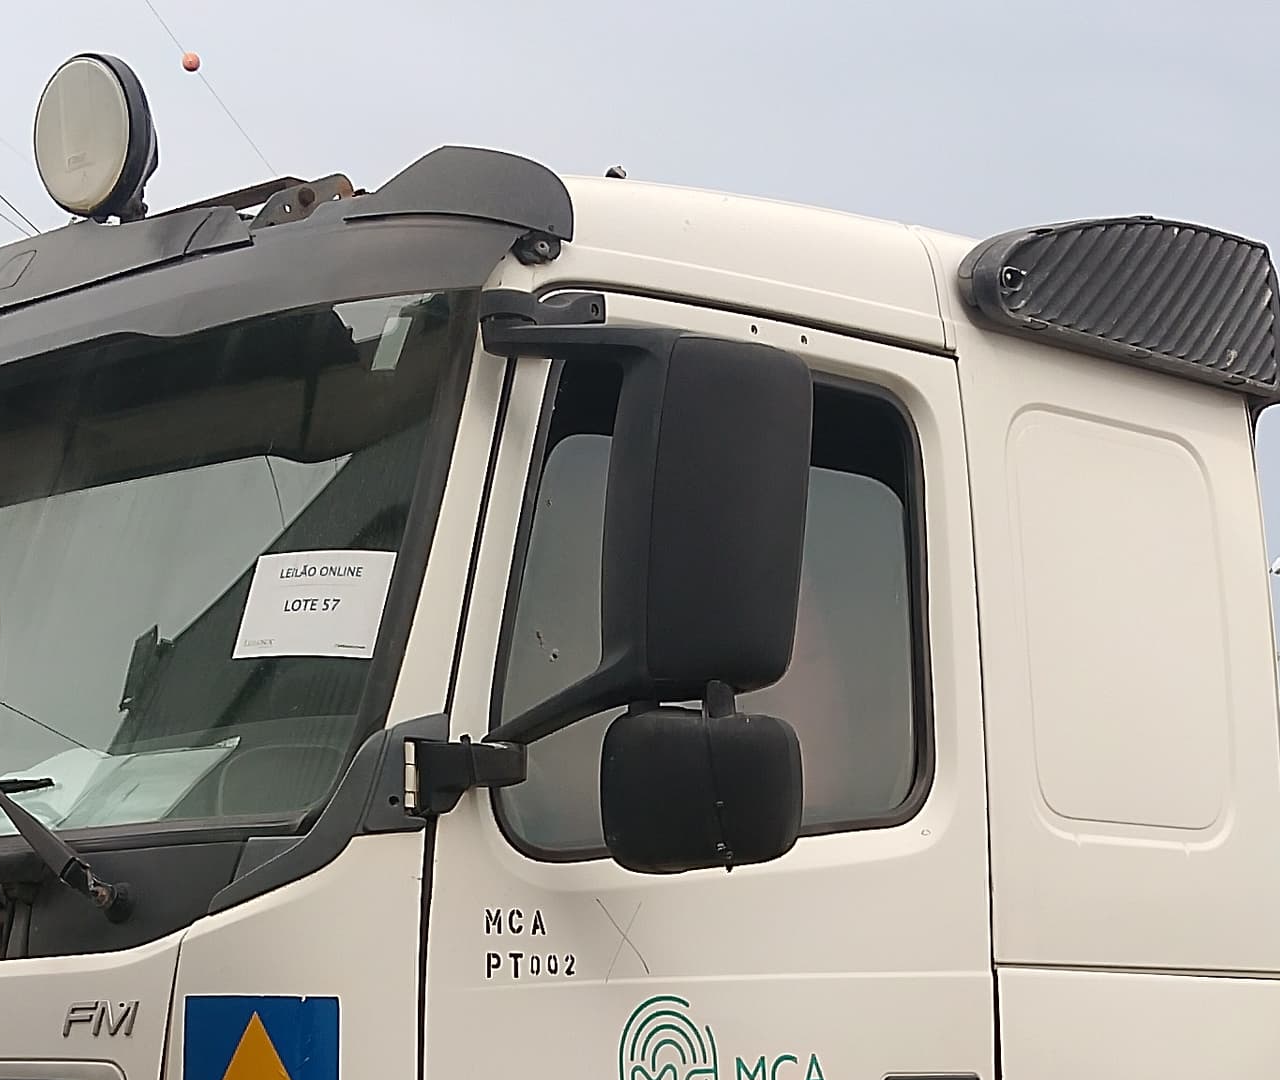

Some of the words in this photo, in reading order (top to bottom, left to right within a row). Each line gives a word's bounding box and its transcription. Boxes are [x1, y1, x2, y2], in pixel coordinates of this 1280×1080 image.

[280, 565, 317, 579] LEILÃO
[320, 566, 363, 578] ONLINE
[284, 599, 318, 612] LOTE
[322, 599, 340, 611] 57
[485, 908, 546, 935] MCA
[486, 952, 576, 979] PT002
[62, 1000, 140, 1037] FM
